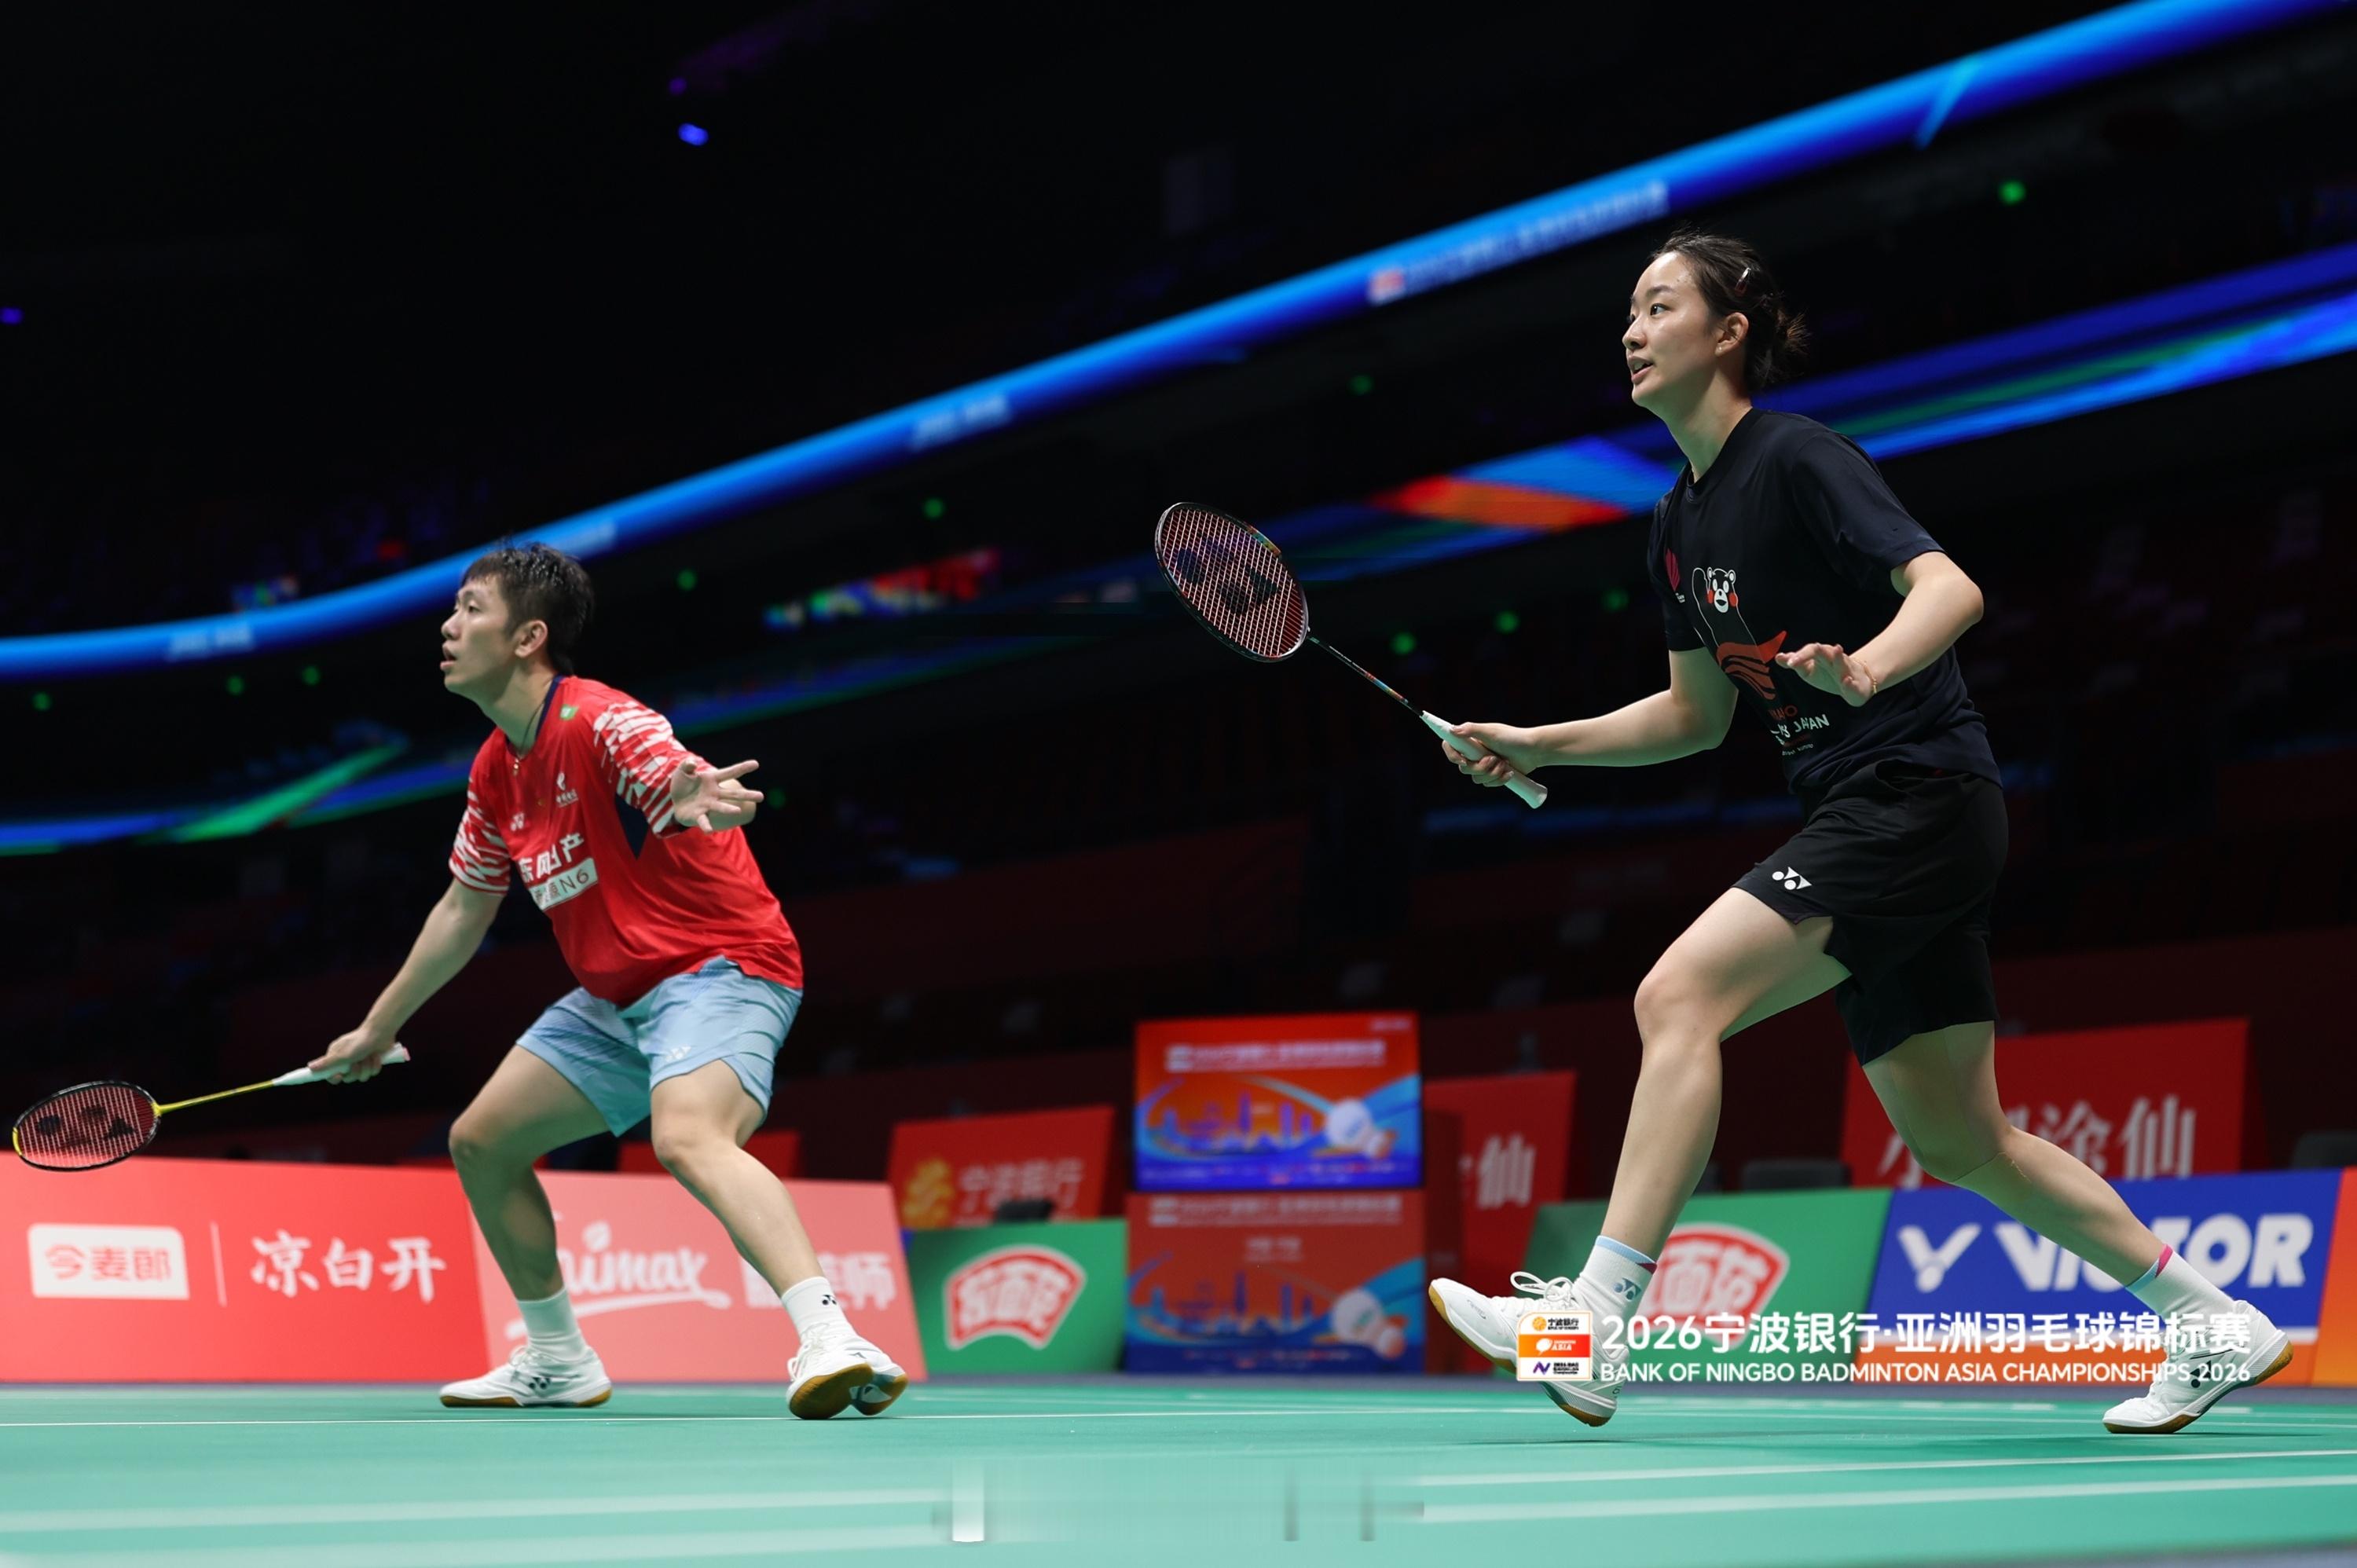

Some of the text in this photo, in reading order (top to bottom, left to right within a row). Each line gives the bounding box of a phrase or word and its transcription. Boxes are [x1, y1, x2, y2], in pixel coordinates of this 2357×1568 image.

[45, 1244, 173, 1282] 今麦郎
[249, 1229, 446, 1304] 凉白开
